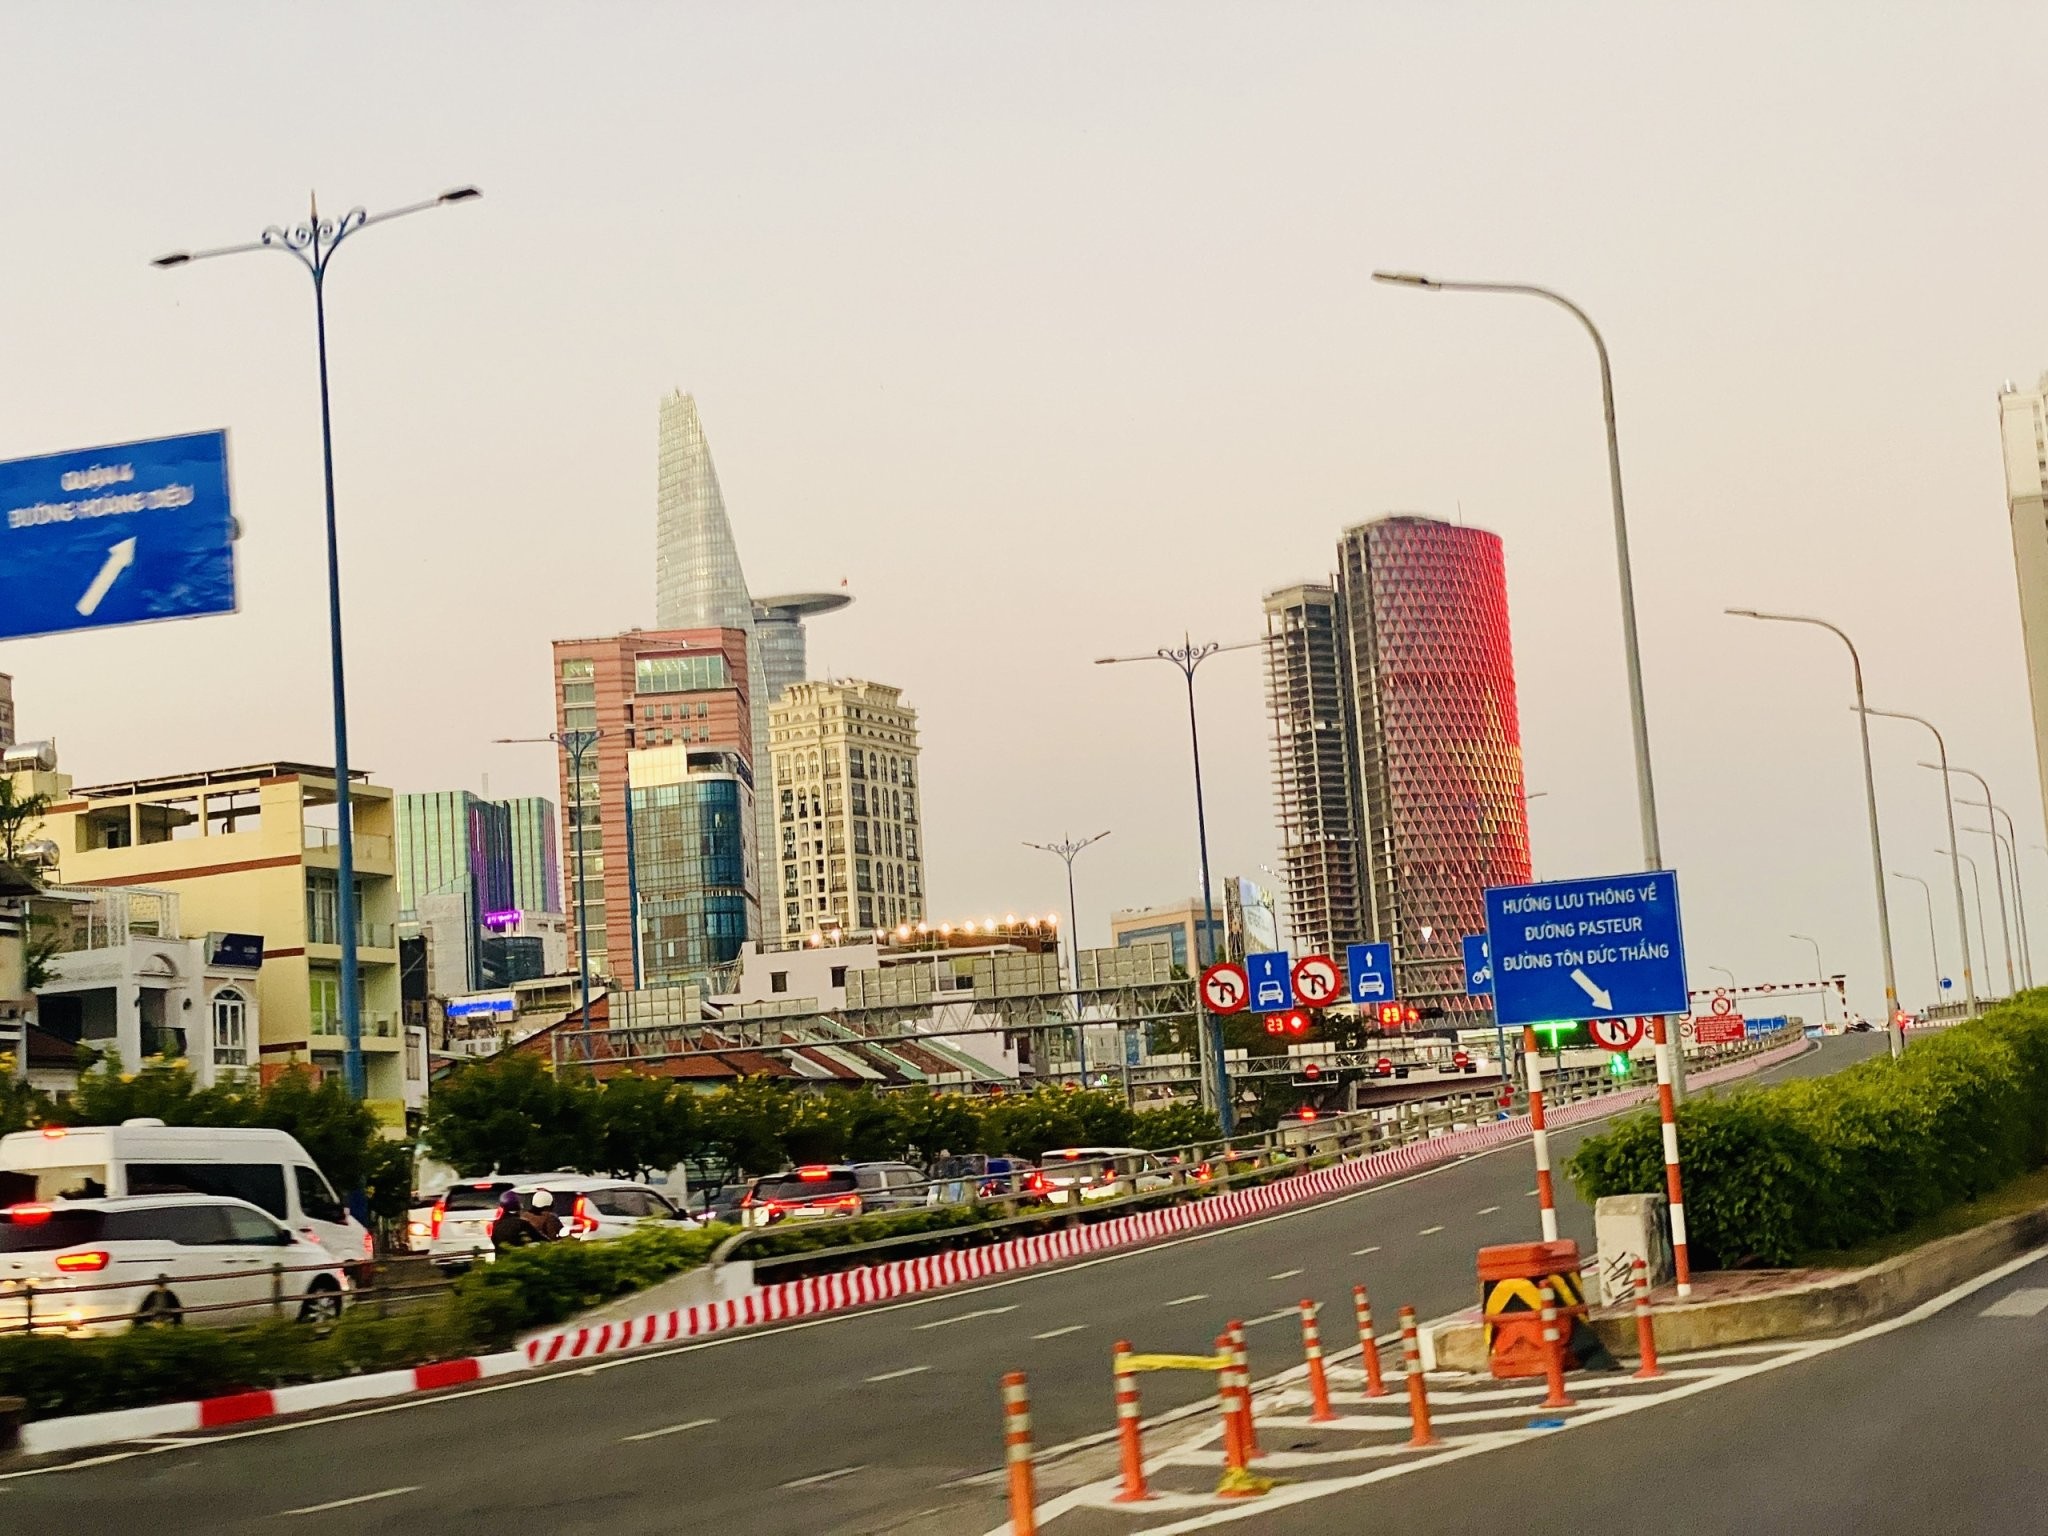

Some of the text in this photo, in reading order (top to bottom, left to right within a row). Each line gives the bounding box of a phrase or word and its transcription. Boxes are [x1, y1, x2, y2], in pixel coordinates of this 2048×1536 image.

[1503, 881, 1657, 914] HƯỚNG LƯU THÔNG VỀ
[1525, 916, 1642, 941] ĐƯỜNG PASTEUR
[1503, 938, 1669, 971] ĐƯỜNG TÔN ĐỨC THẮNG
[1267, 1018, 1284, 1032] 23
[1383, 1007, 1399, 1023] 23
